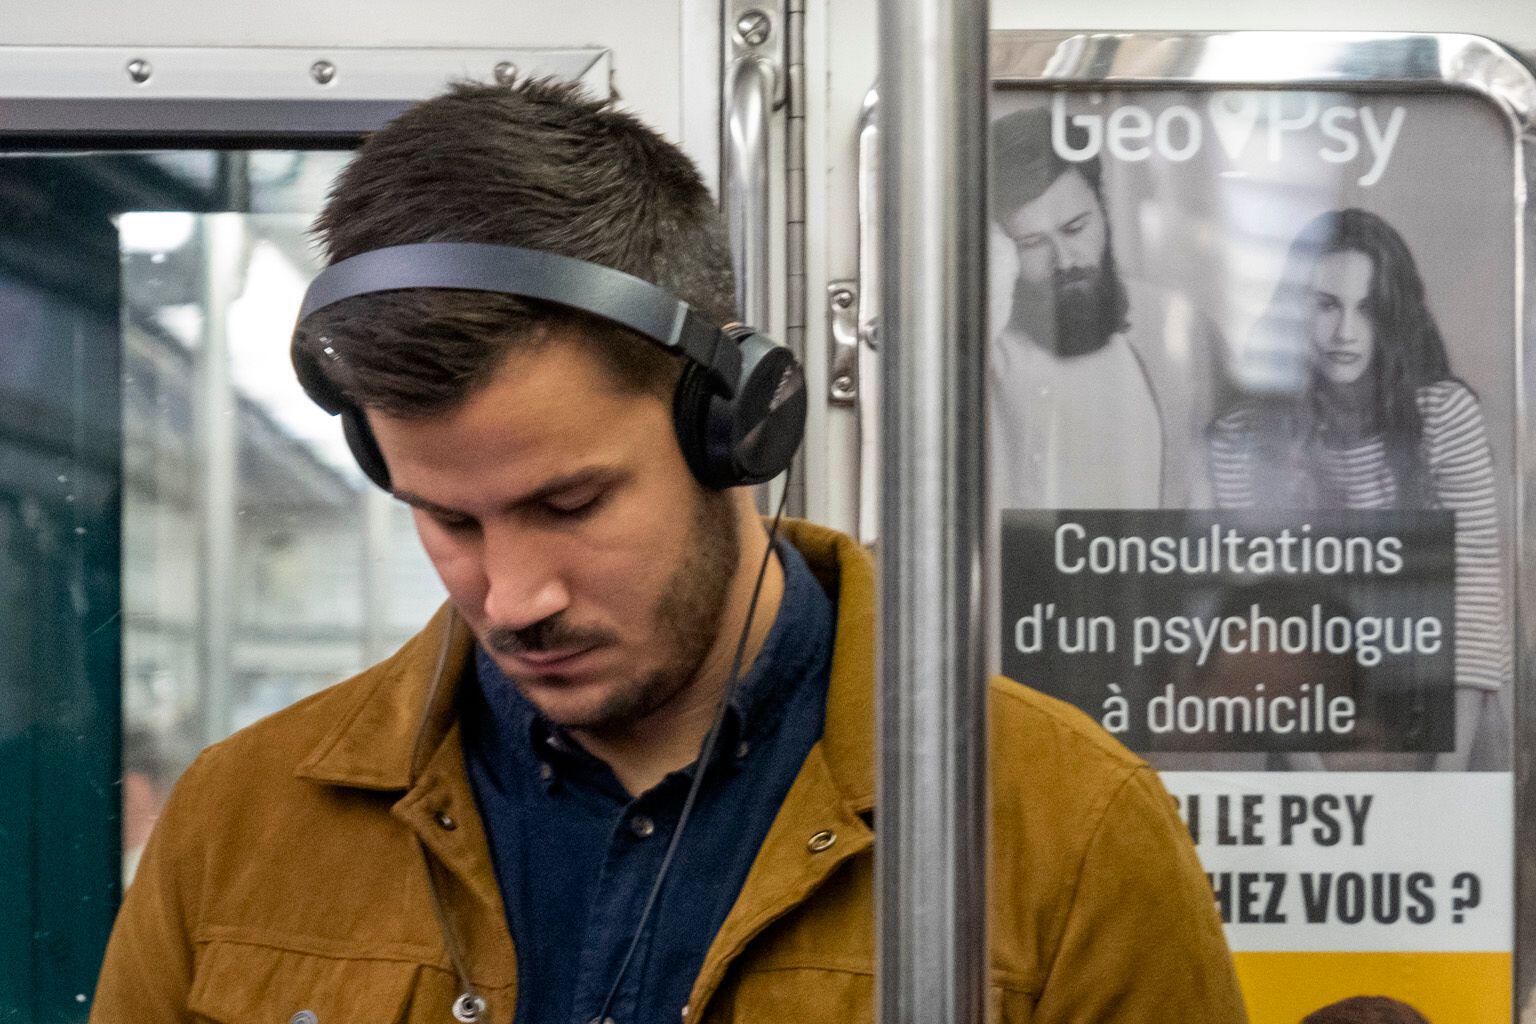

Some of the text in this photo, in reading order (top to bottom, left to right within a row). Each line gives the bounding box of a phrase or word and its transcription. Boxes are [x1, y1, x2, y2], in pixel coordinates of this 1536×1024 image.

[1052, 91, 1406, 185] Geo Psy
[1054, 523, 1403, 574] Consultations
[1014, 603, 1443, 667] d'un psychologue
[1101, 683, 1357, 734] à domicile
[1217, 794, 1264, 846] LE
[1279, 793, 1374, 847] PSY
[1300, 871, 1436, 925] VOUS
[1451, 871, 1482, 924] ?
